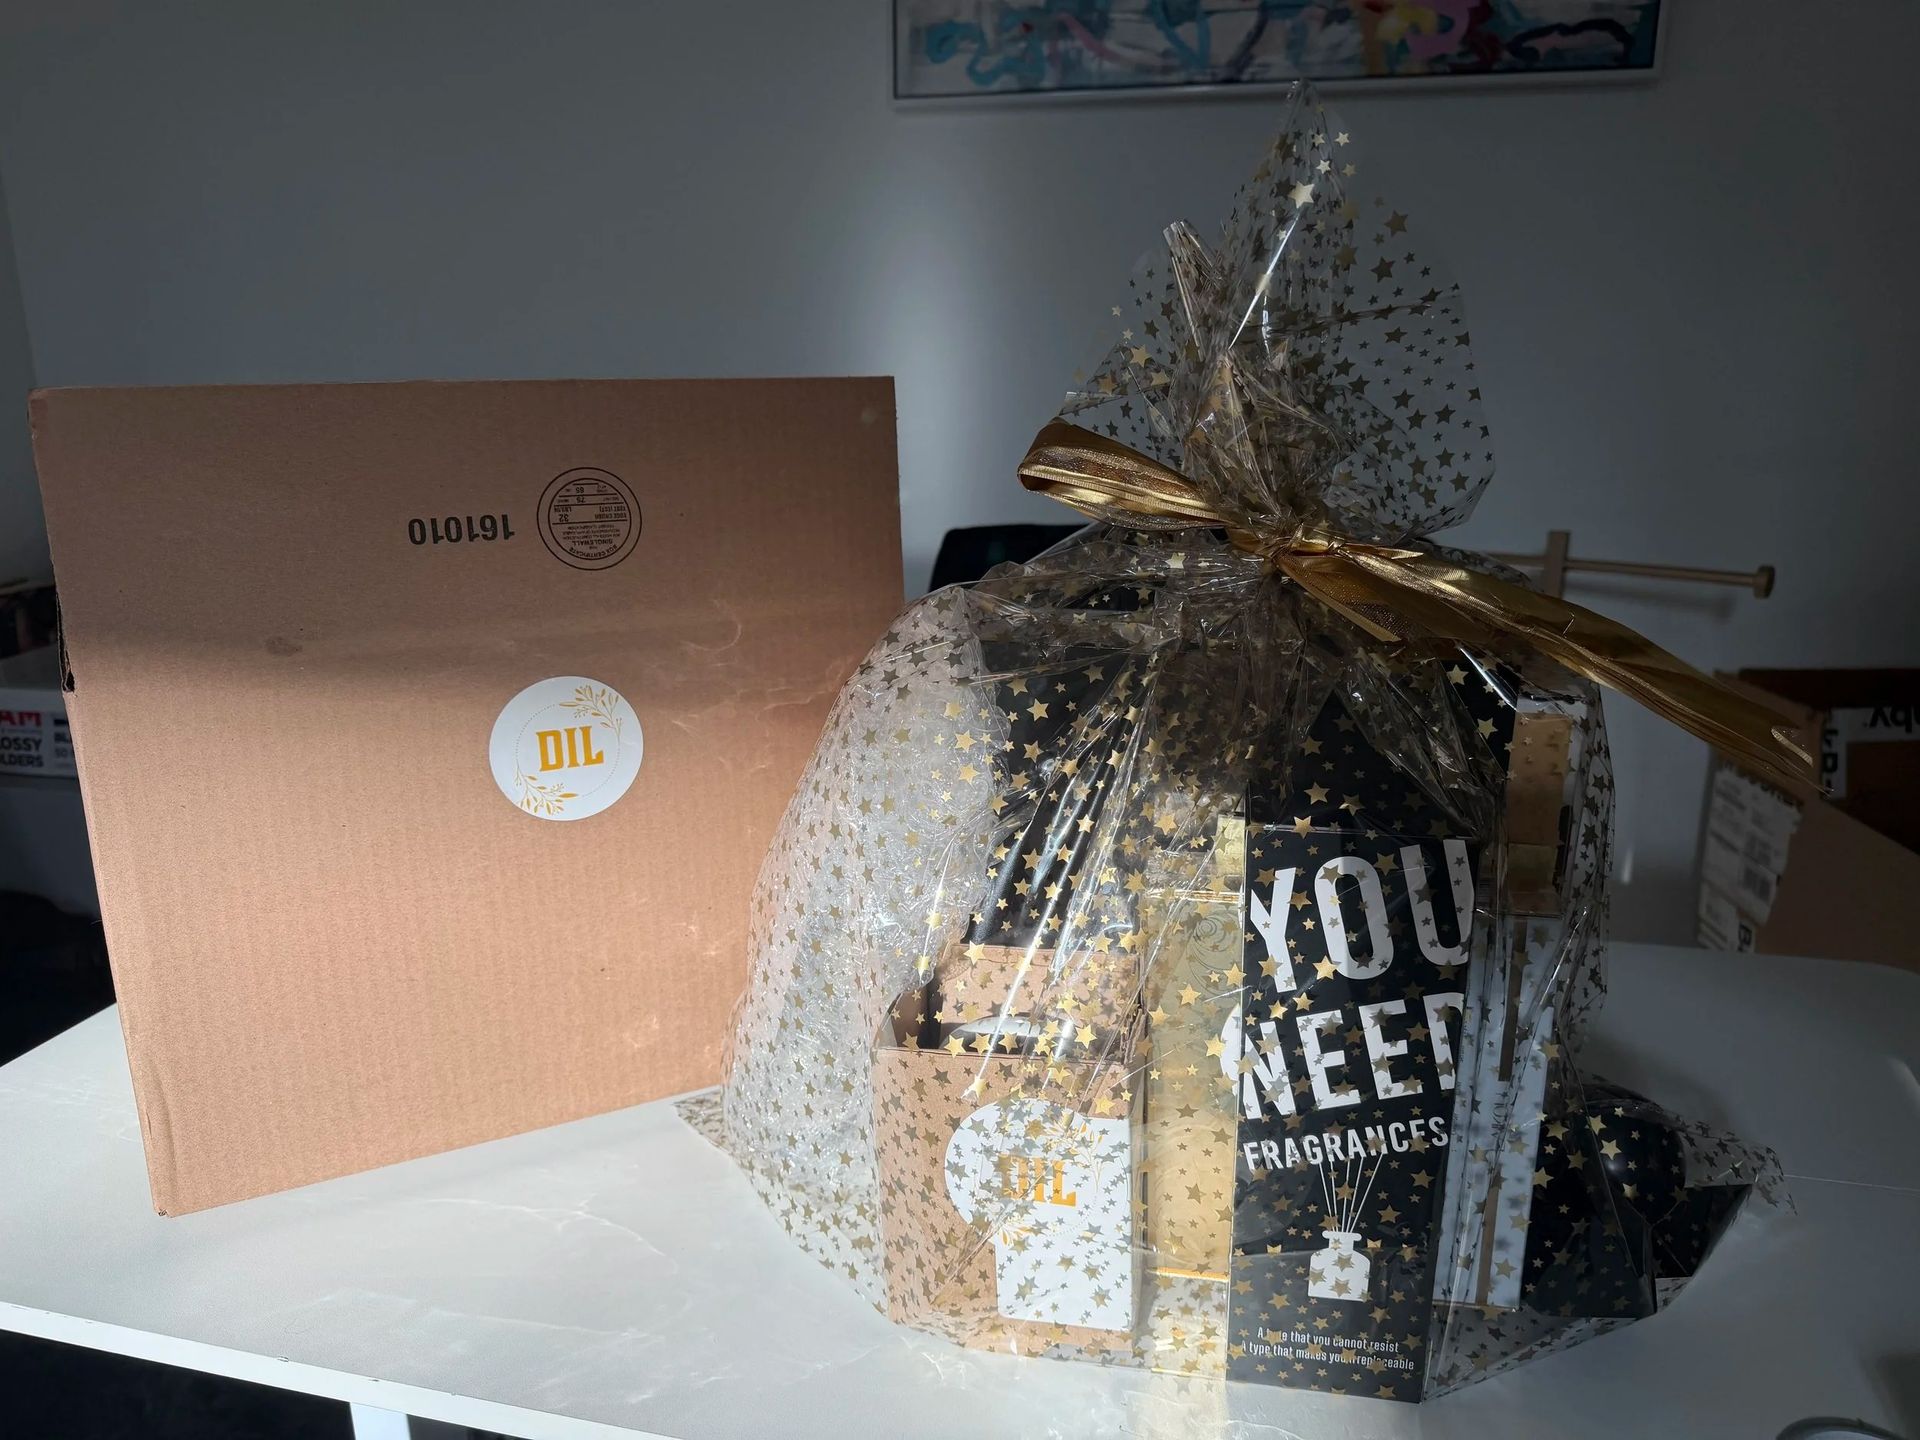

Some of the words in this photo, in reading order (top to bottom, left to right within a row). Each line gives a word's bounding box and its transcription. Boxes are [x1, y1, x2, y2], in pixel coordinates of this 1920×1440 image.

[408, 514, 515, 546] 161010
[558, 513, 570, 522] 32
[0, 736, 43, 752] OSSY
[536, 725, 604, 772] DIL
[1250, 839, 1475, 993] YOU
[1243, 1116, 1449, 1171] FRAGRANCES
[1249, 1341, 1271, 1357] type
[1273, 1344, 1293, 1357] that
[1257, 1326, 1264, 1339] A
[1290, 1330, 1311, 1344] that
[1332, 1338, 1368, 1350] cannot
[1370, 1340, 1400, 1353] resist
